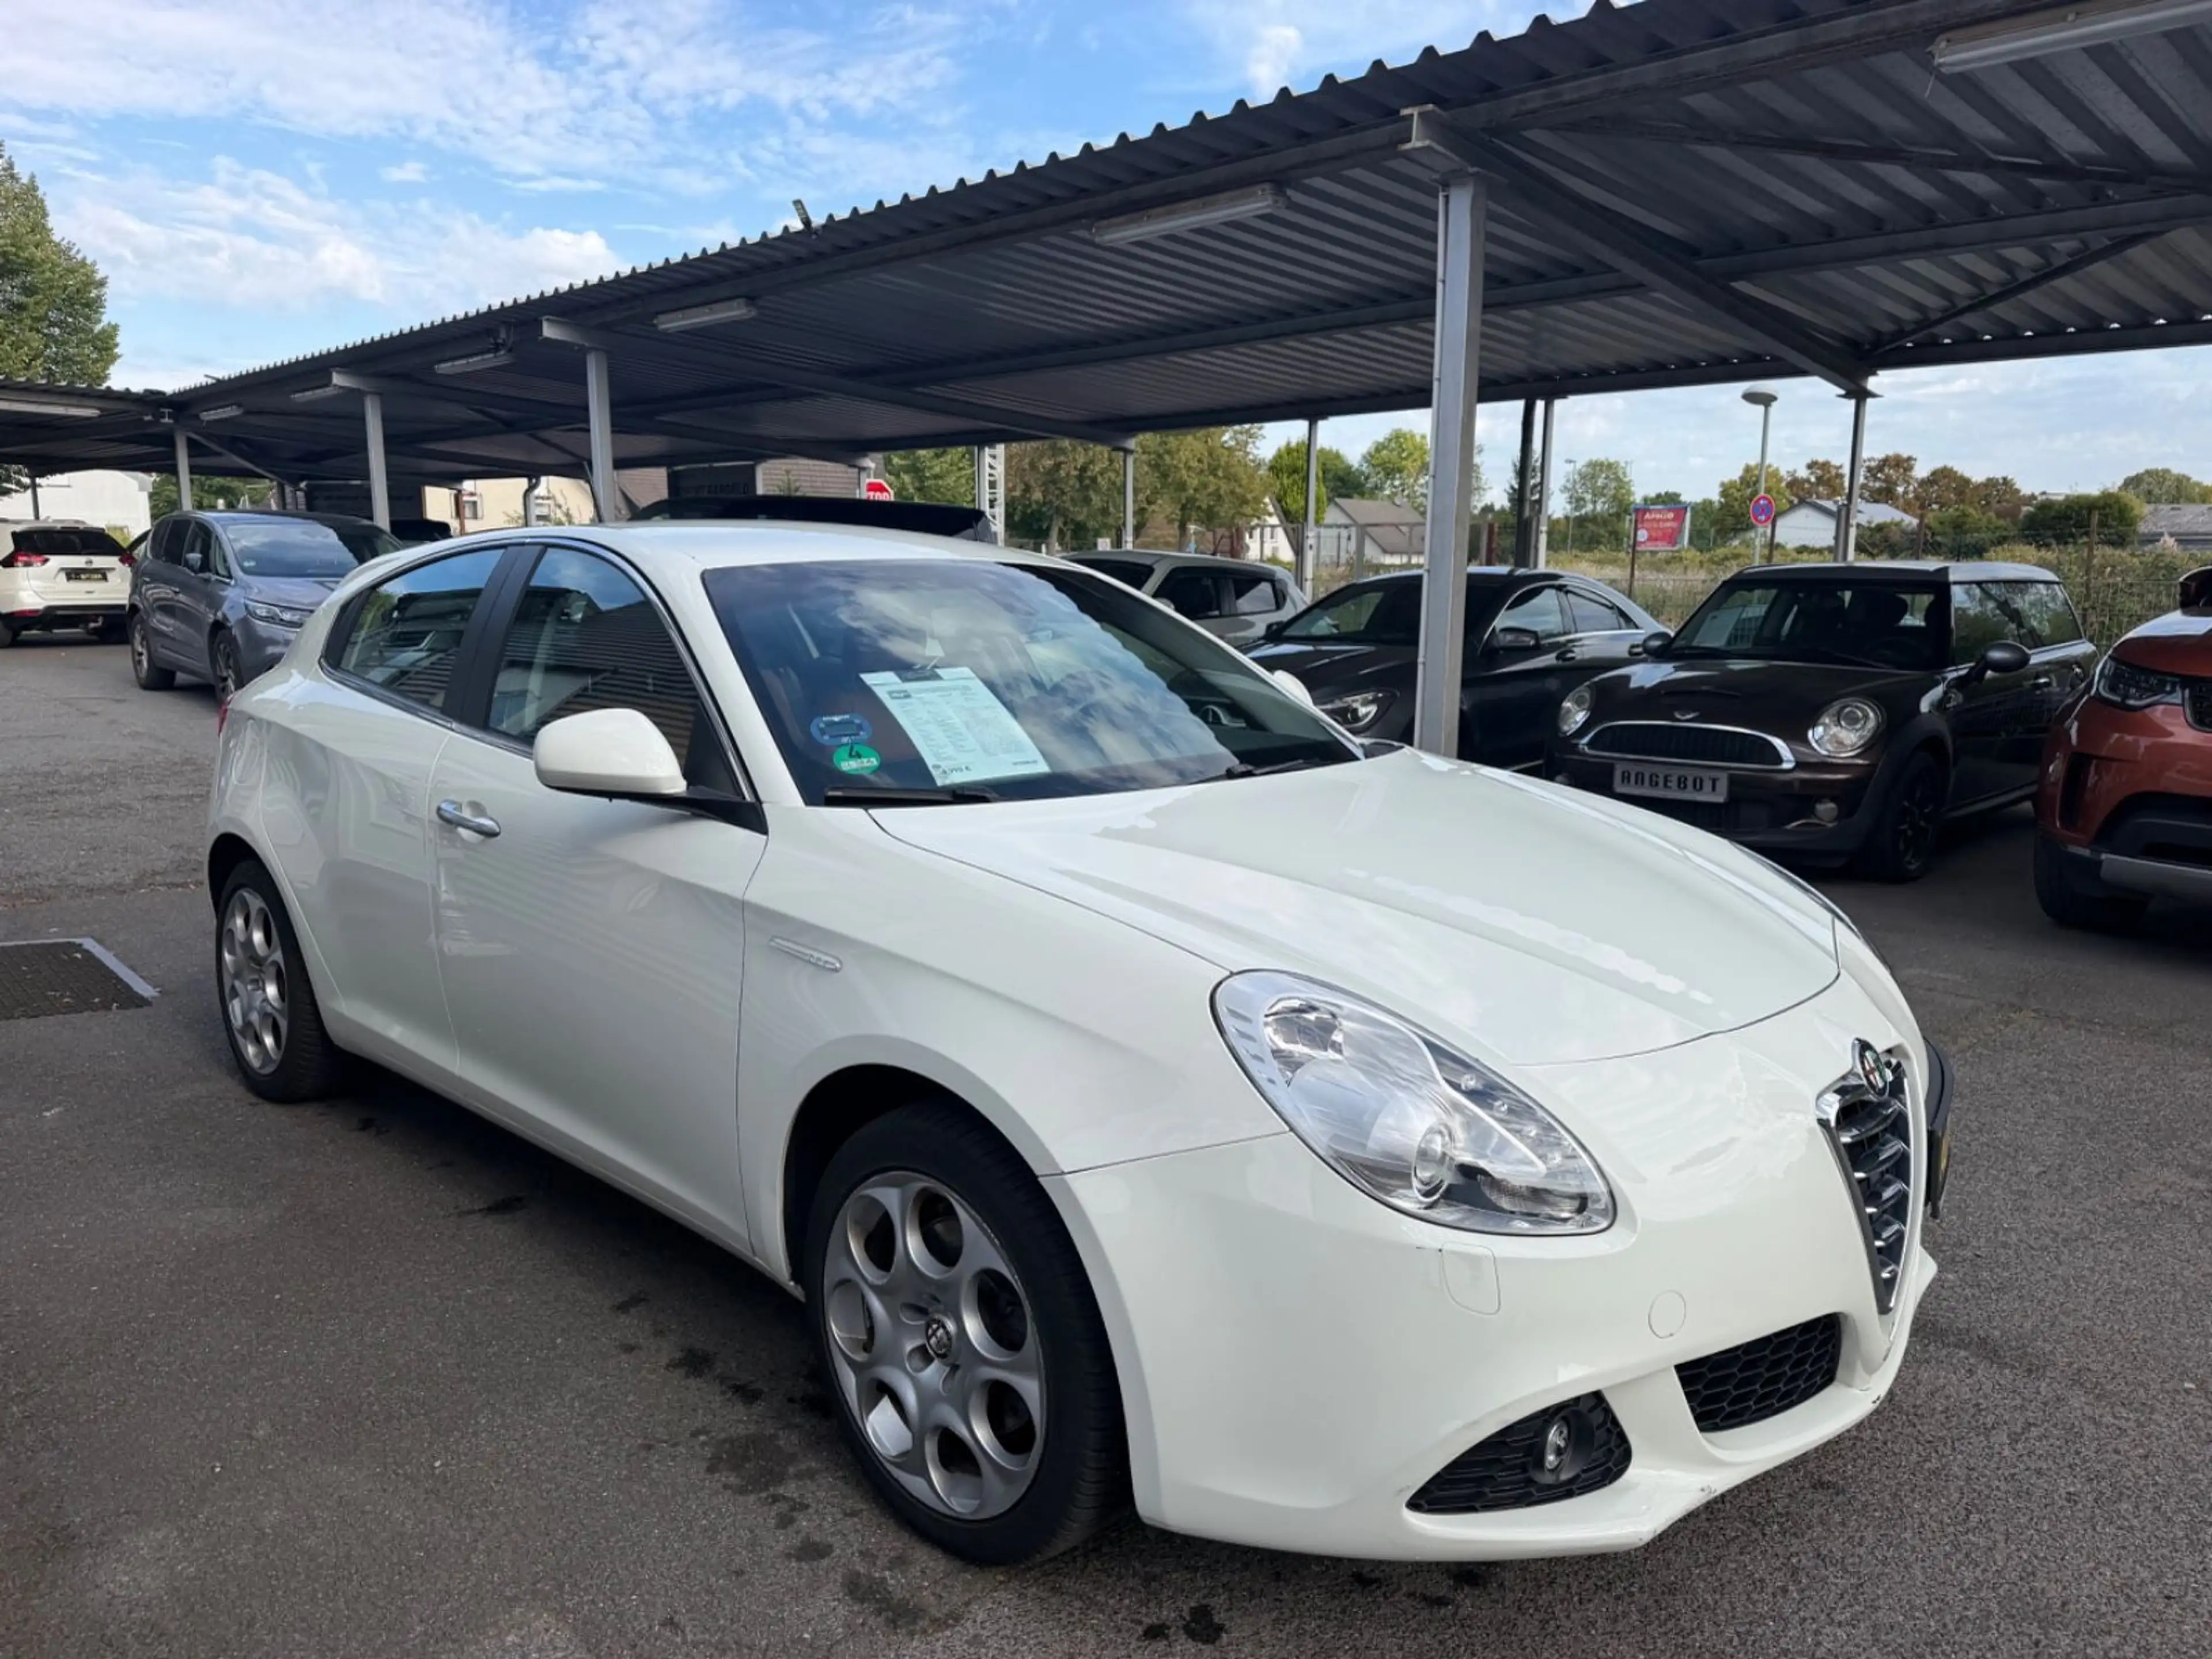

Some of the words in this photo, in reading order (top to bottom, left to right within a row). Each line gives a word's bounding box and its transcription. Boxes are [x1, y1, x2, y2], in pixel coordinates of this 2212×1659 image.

[867, 491, 890, 501] TOP
[849, 737, 862, 759] 4
[1620, 770, 1720, 792] ANGEBOT
